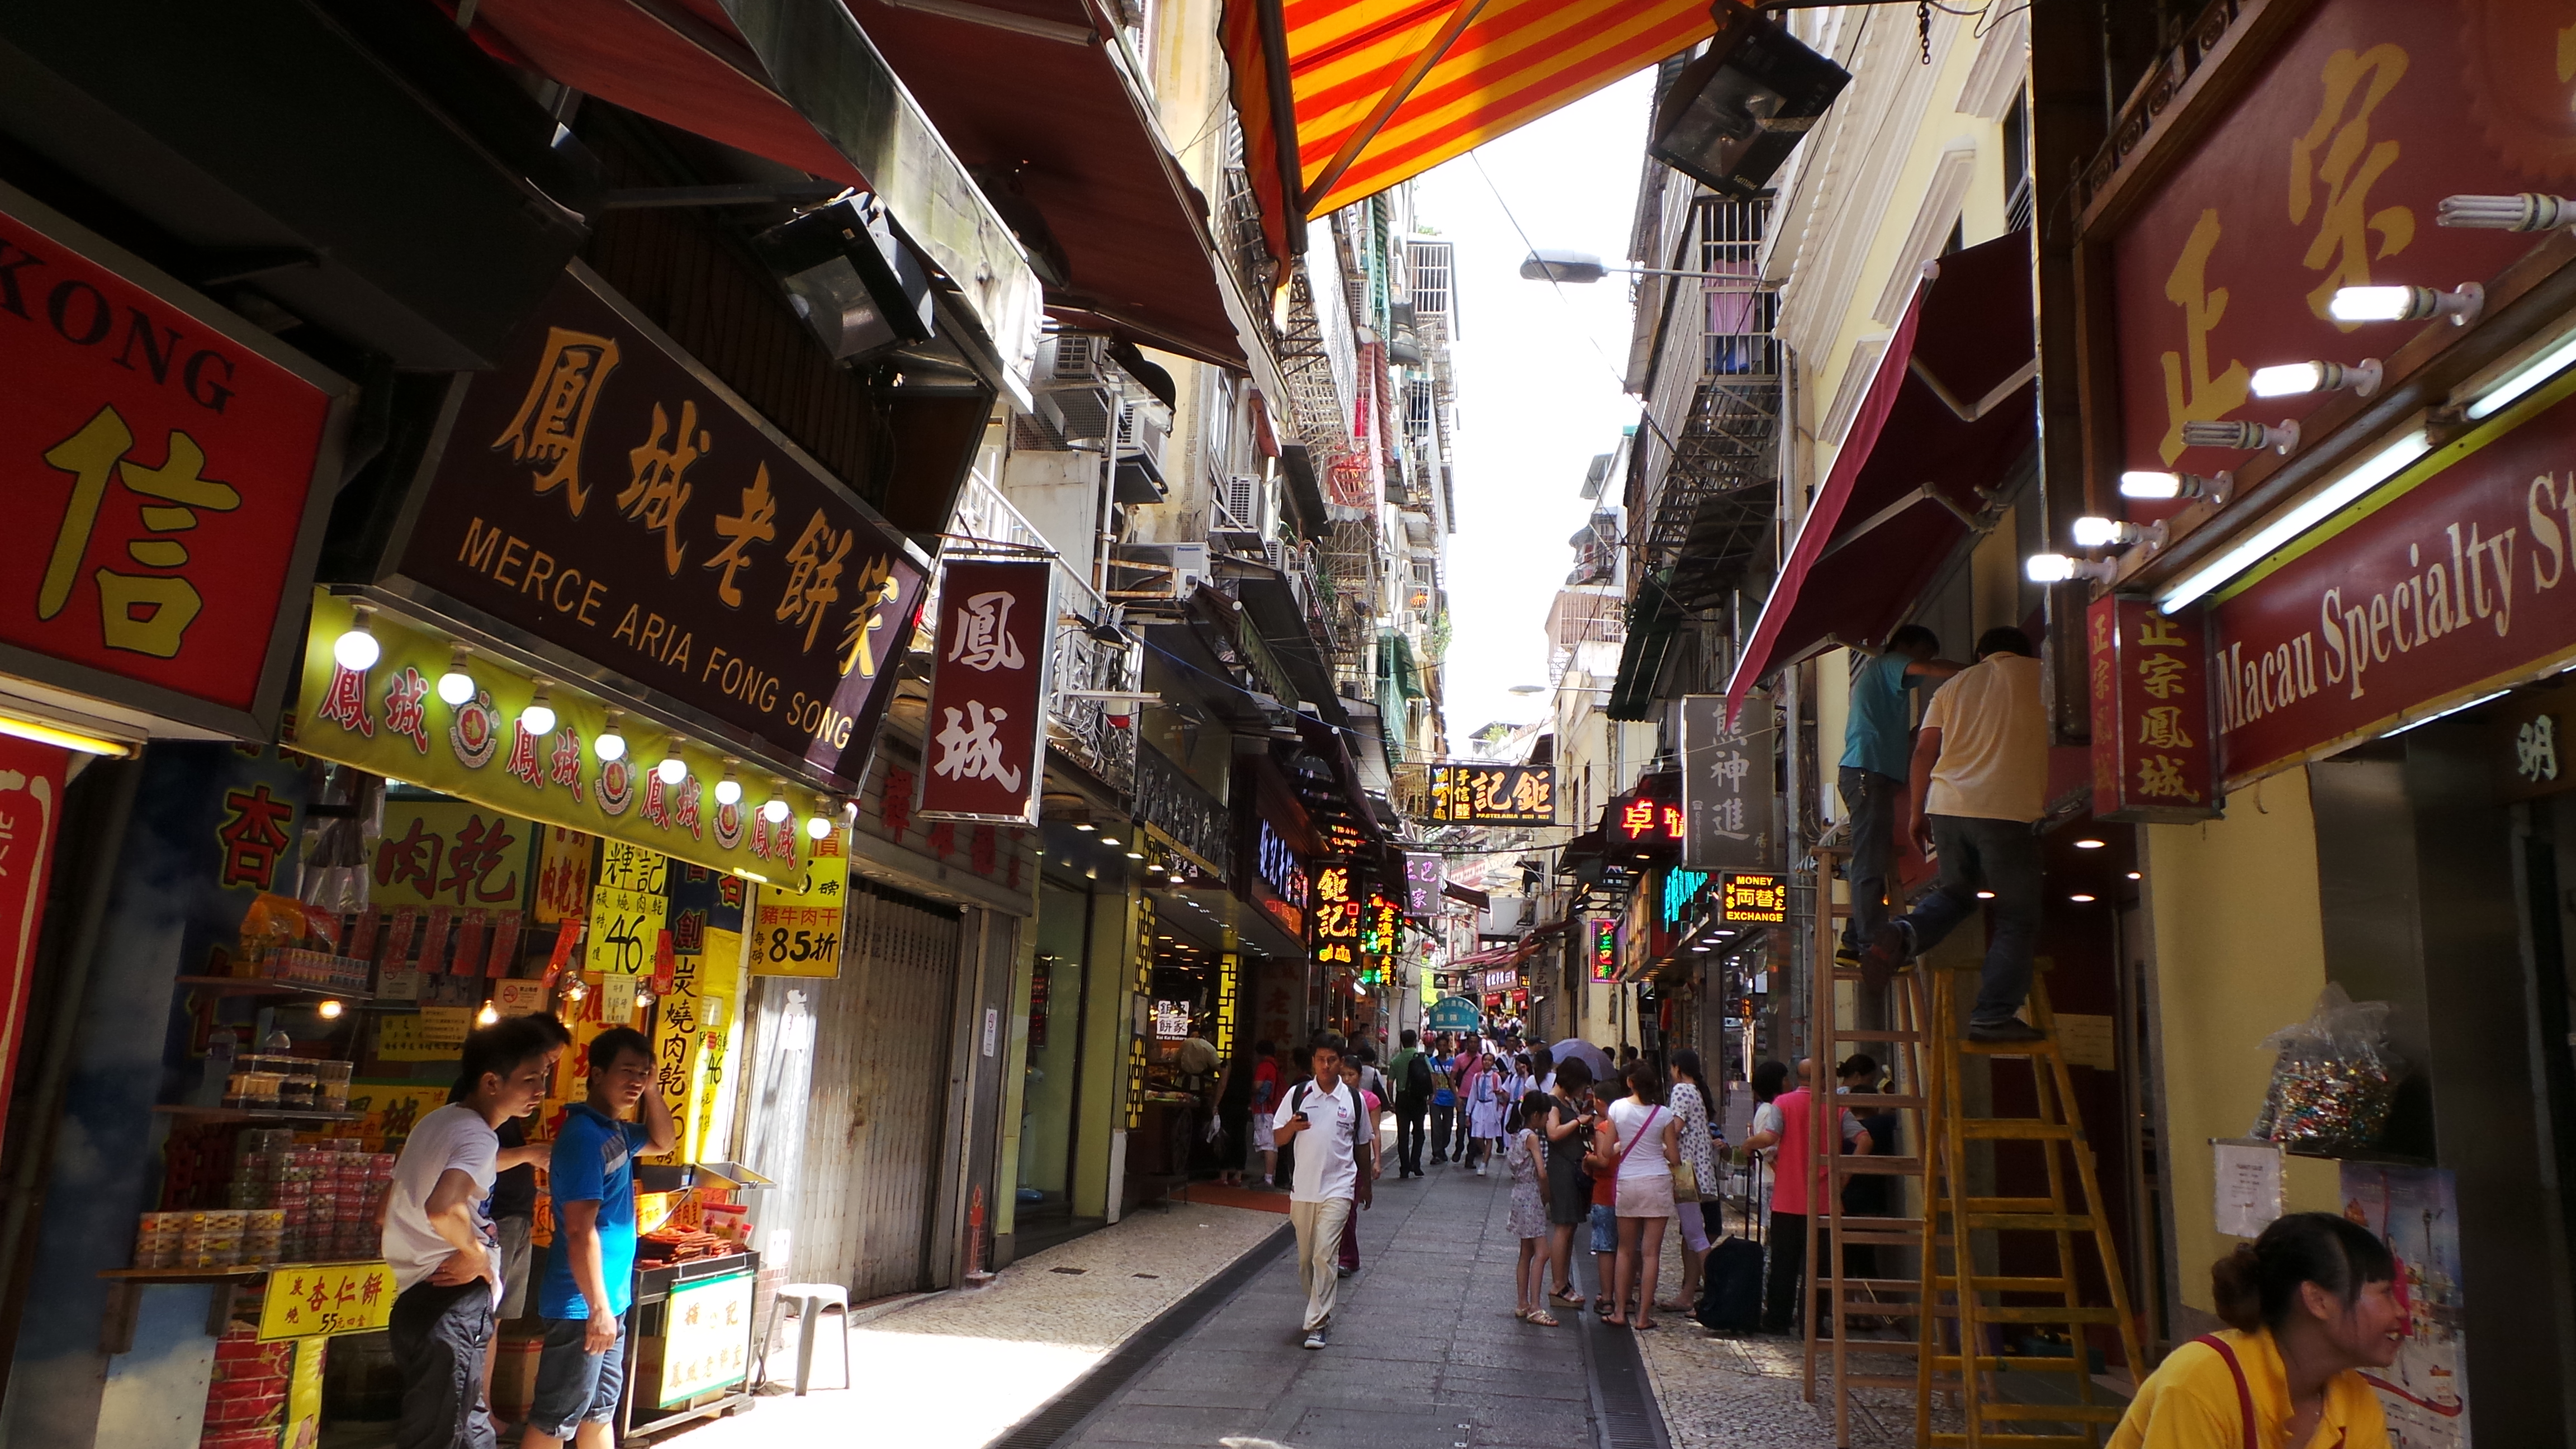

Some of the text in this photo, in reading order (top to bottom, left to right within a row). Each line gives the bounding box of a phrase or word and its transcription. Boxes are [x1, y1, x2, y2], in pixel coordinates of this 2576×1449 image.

[42, 402, 242, 659] 信
[490, 326, 899, 679] 鳳城老餅家
[457, 516, 853, 750] MERCE ARIA FONG SONG
[2217, 631, 2318, 736] Macau
[2322, 522, 2517, 700] Specialty
[319, 662, 429, 755] 鳳城
[934, 590, 1025, 793] 鳳城
[2138, 609, 2200, 803] 正宗鳳城
[506, 716, 582, 803] 鳳城
[2517, 714, 2560, 782] 明
[640, 766, 701, 841] 鳳城
[1454, 769, 1470, 802] 手信
[375, 815, 515, 905] 肉乾
[748, 804, 797, 870] 鳳城
[818, 879, 839, 896] 磅
[1317, 868, 1349, 938] 鉅記
[1736, 875, 1773, 886] MONEY
[1736, 888, 1774, 907] 両替
[605, 913, 646, 974] 46
[761, 906, 838, 927] 豬牛肉干
[769, 927, 837, 963] 85折
[1377, 906, 1395, 951] 老澳門
[1726, 911, 1783, 922] EXCHANGE
[657, 956, 698, 1097] 炭燒肉乾
[1159, 1019, 1186, 1033] 餅家
[307, 1273, 383, 1313] 杏仁餅
